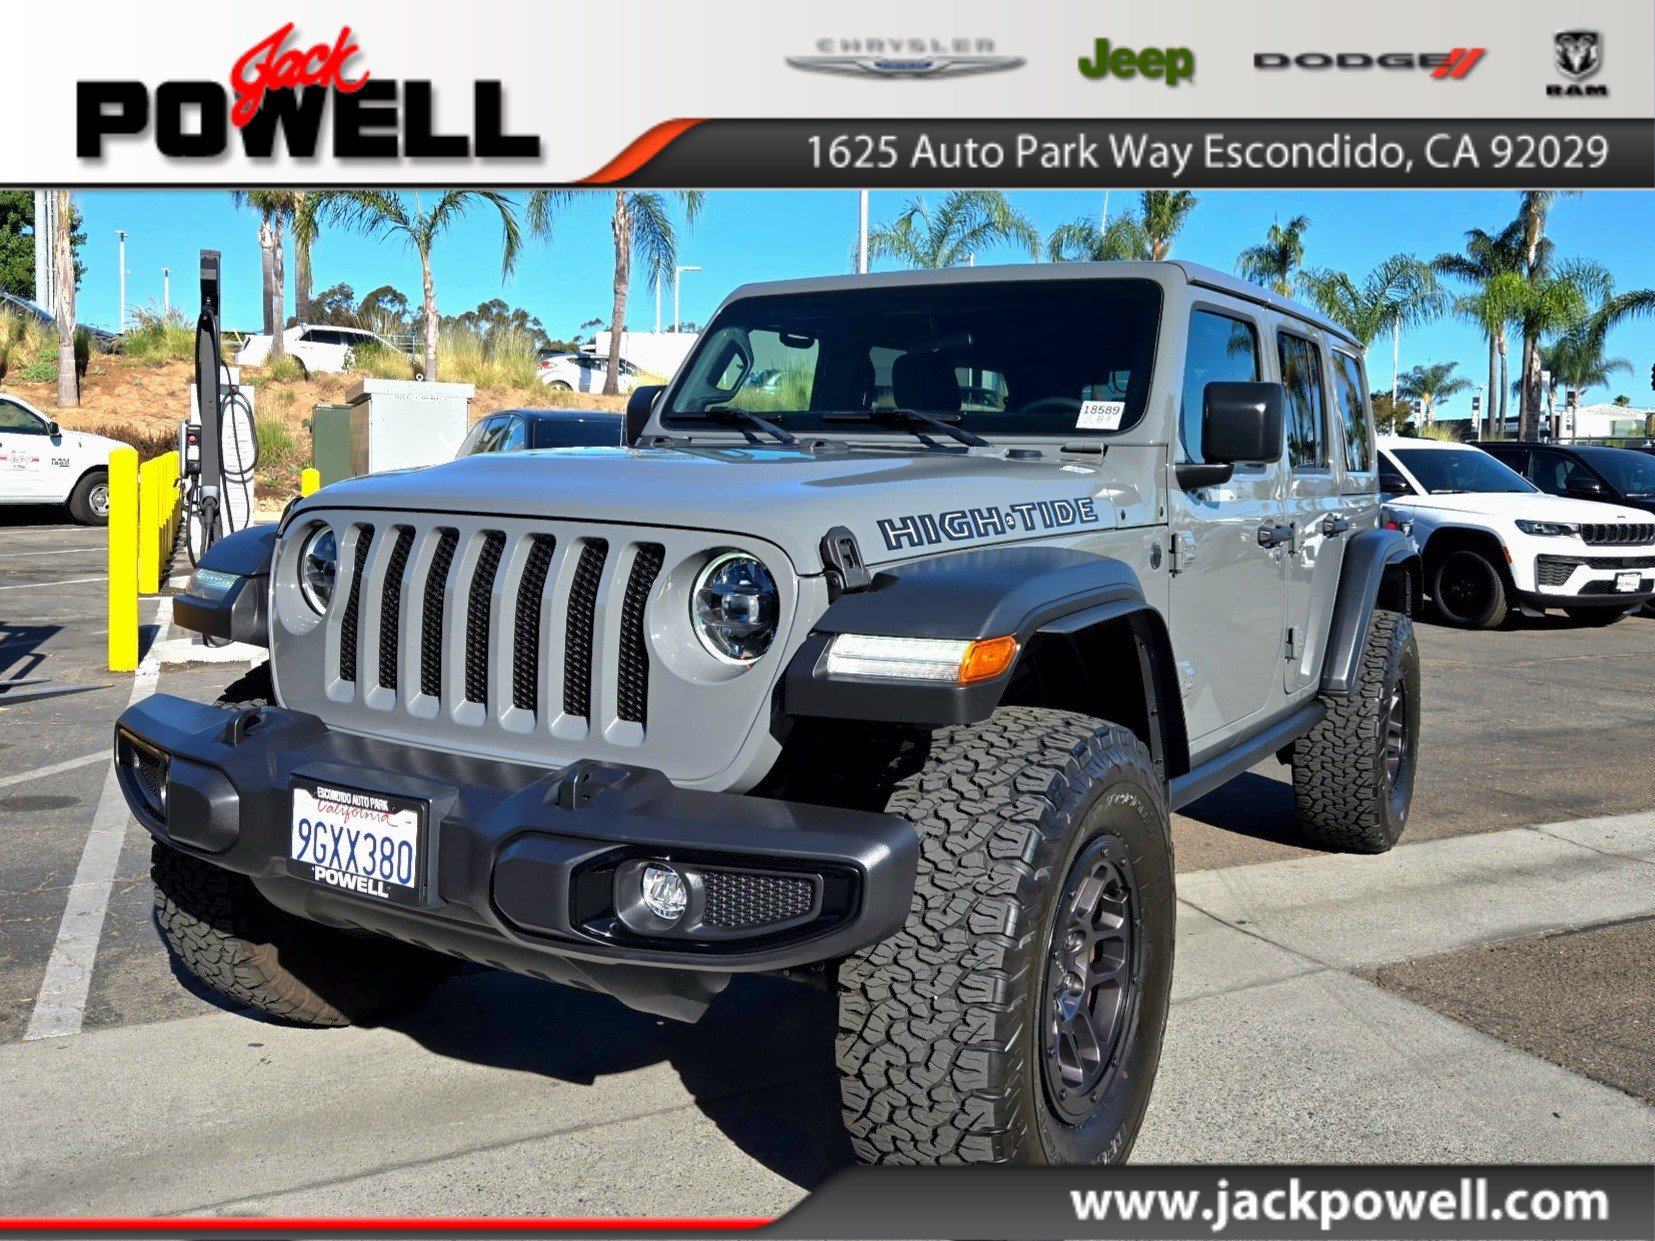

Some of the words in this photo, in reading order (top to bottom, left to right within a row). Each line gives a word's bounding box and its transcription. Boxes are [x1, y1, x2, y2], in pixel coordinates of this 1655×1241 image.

[1083, 405, 1120, 415] 18589
[317, 786, 352, 804] ESCONDIDO
[352, 794, 370, 808] AUTO
[370, 798, 388, 811] PARK
[317, 800, 398, 827] California
[297, 818, 413, 885] 9GXX380
[314, 865, 389, 898] POWELL
